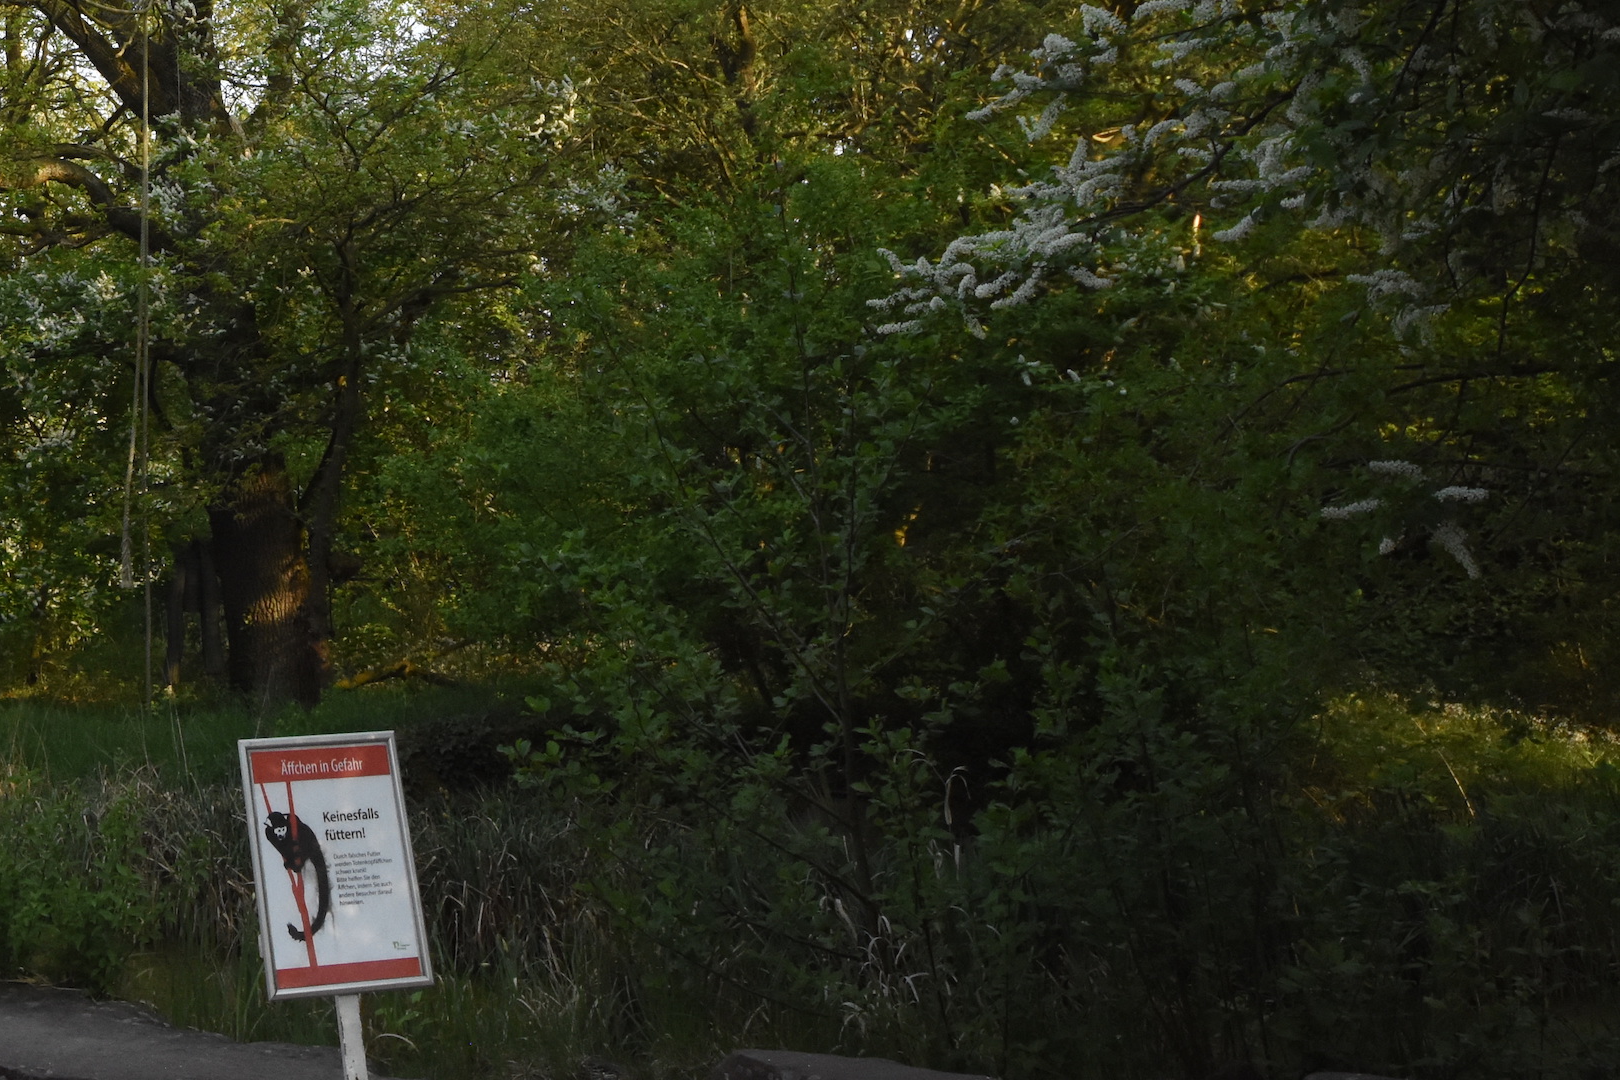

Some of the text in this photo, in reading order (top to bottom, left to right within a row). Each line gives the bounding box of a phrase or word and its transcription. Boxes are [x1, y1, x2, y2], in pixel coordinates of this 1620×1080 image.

[281, 757, 363, 776] Äffchen in Gefahr
[322, 807, 380, 823] Keinesfalls
[325, 827, 366, 841] füttern!
